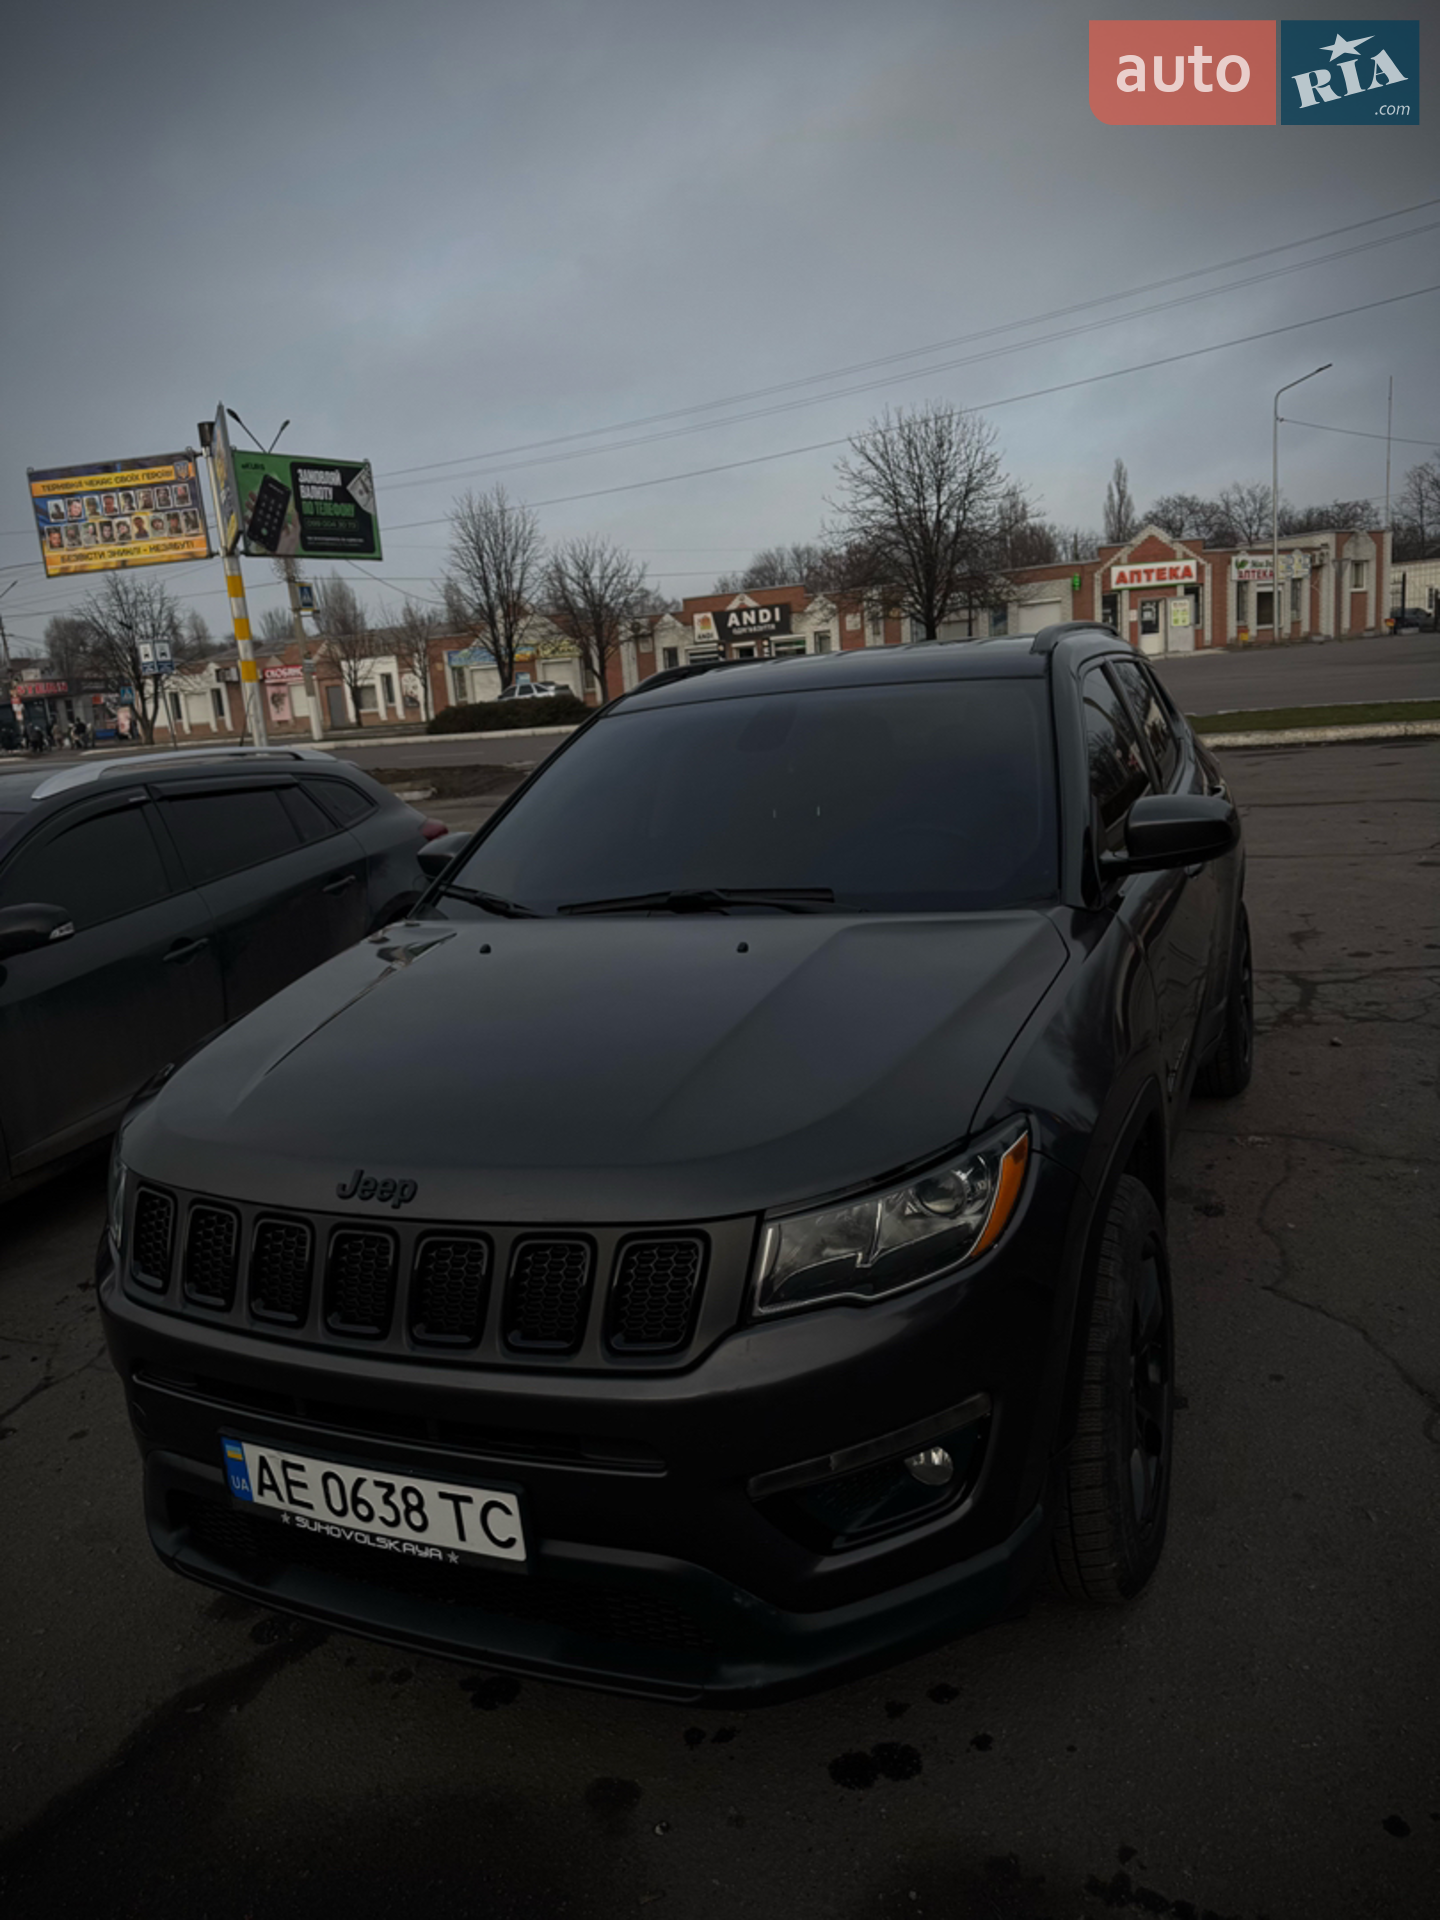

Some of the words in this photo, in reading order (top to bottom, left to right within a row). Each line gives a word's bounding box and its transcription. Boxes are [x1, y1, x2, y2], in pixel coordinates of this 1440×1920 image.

[115, 474, 140, 485] СВОЇХ
[1115, 565, 1194, 585] АПТЕКА
[727, 607, 781, 628] ANDI
[336, 1169, 418, 1209] Jeep
[230, 1474, 250, 1493] UA
[257, 1454, 314, 1511] AE
[321, 1470, 429, 1533] 0638
[438, 1491, 517, 1549] TC
